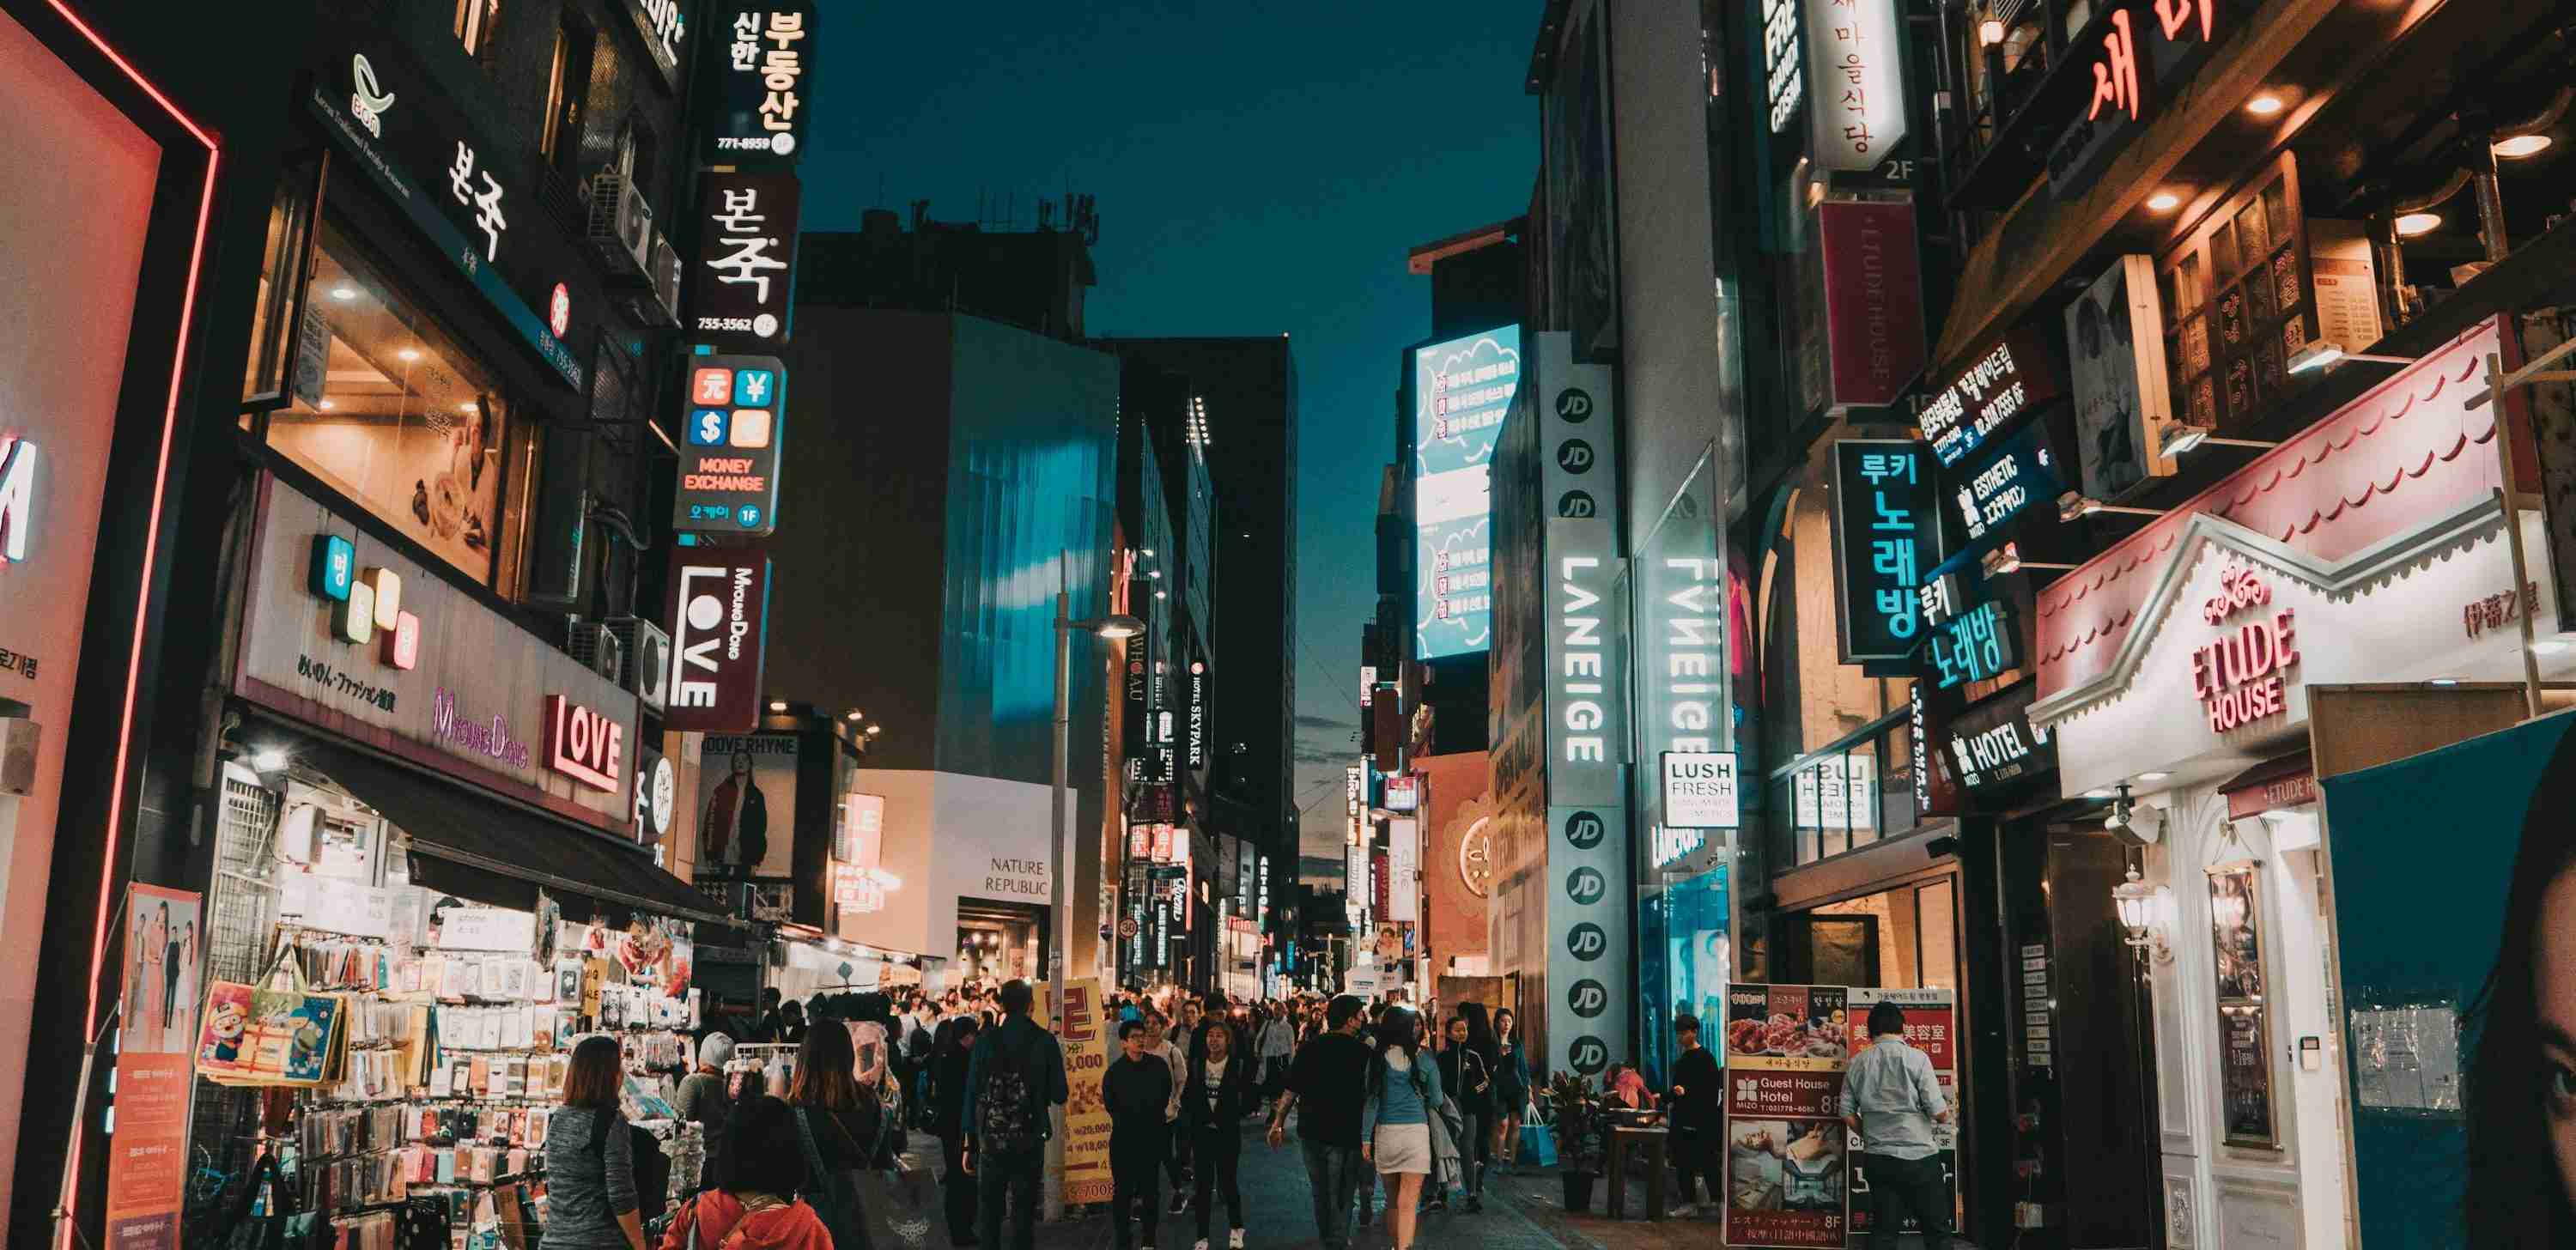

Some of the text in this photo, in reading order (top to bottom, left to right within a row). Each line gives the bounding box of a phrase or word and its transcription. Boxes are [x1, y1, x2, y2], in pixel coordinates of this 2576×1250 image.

[731, 12, 760, 70] 신한
[759, 12, 805, 130] 부동산
[718, 137, 770, 149] 771-8959
[1886, 161, 1913, 179] 2F
[449, 141, 506, 263] 본죽
[707, 188, 787, 304] 본죽
[697, 318, 751, 331] 755-3562
[699, 458, 753, 473] MONEY
[1861, 454, 1917, 485] 루키
[1972, 453, 2018, 501] ESTHETIC
[684, 475, 765, 491] EXCHANGE
[742, 510, 756, 521] 1F
[1872, 491, 1921, 638] 노래방
[1921, 574, 1952, 626] 루키
[670, 566, 727, 707] LOVE
[1933, 603, 2002, 689] 노래방
[1562, 557, 1605, 762] LANEIGE
[2191, 610, 2296, 701] ETUDE
[2208, 677, 2287, 734] HOUSE
[1189, 677, 1202, 765] HOTEL SKYPARK
[554, 694, 623, 793] LOVE
[745, 737, 799, 755] RHYME
[1970, 722, 2029, 770] HOTEL
[1672, 763, 1730, 779] LUSH
[1673, 782, 1731, 797] FRESH
[2269, 779, 2305, 805] ETUDE
[991, 858, 1044, 876] NATURE
[986, 877, 1048, 895] REPUBLIC
[1121, 923, 1135, 933] 30
[1760, 1077, 1830, 1090] Guest House
[1760, 1090, 1794, 1103] Hotel
[1736, 1101, 1758, 1110] MIZO
[1825, 1216, 1841, 1228] 8F
